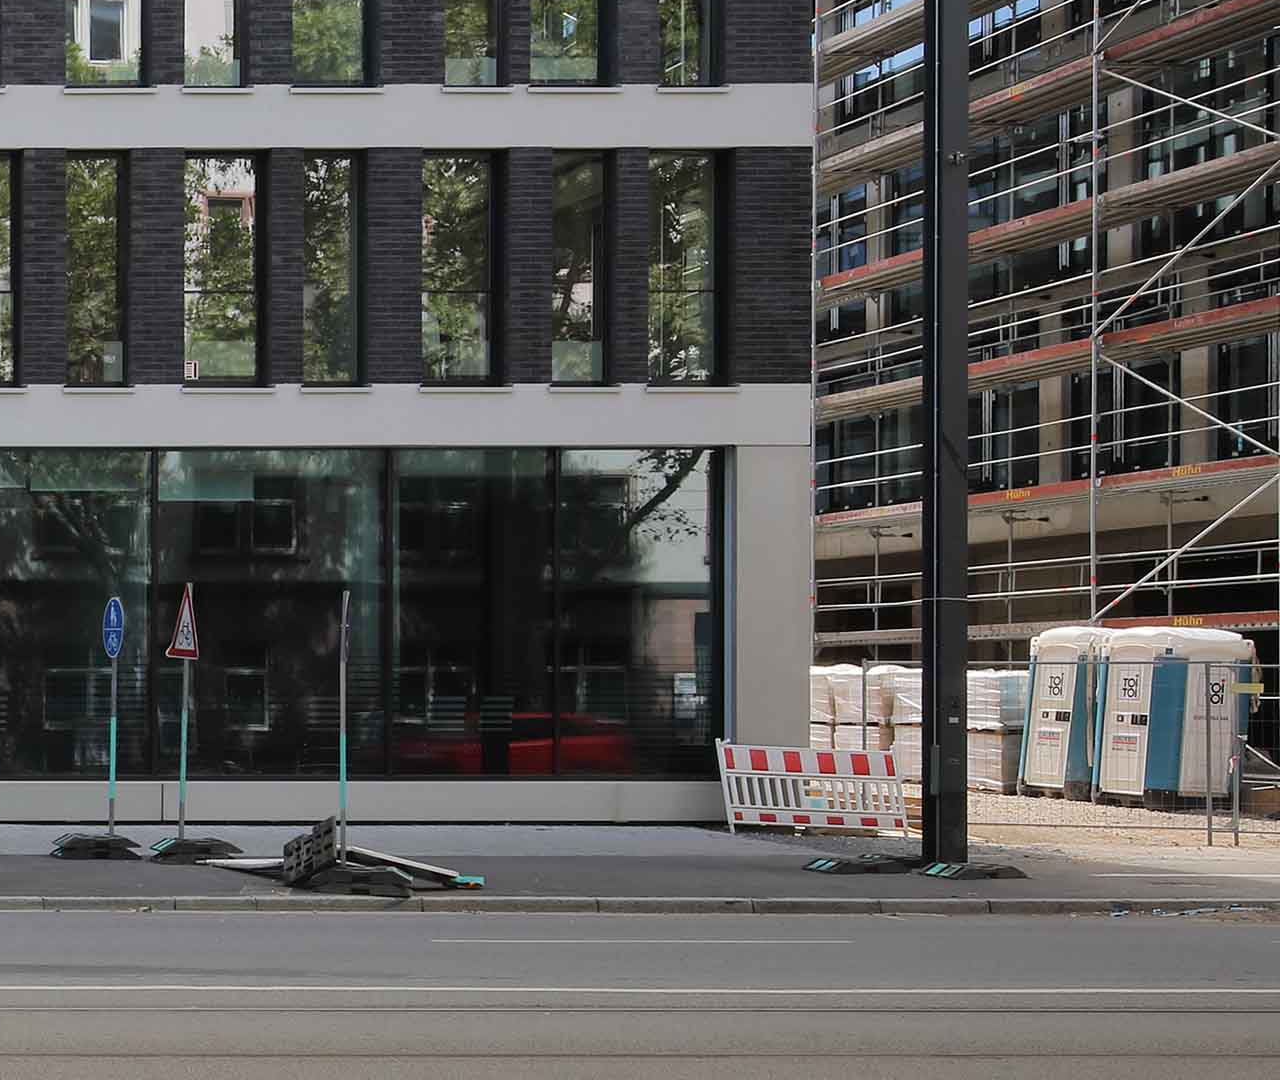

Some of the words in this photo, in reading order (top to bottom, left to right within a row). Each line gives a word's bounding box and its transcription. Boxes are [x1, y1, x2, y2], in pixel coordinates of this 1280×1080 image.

[1048, 685, 1063, 696] TOI
[1209, 679, 1225, 693] OI
[1122, 687, 1138, 698] TOI
[1209, 694, 1224, 705] OI
